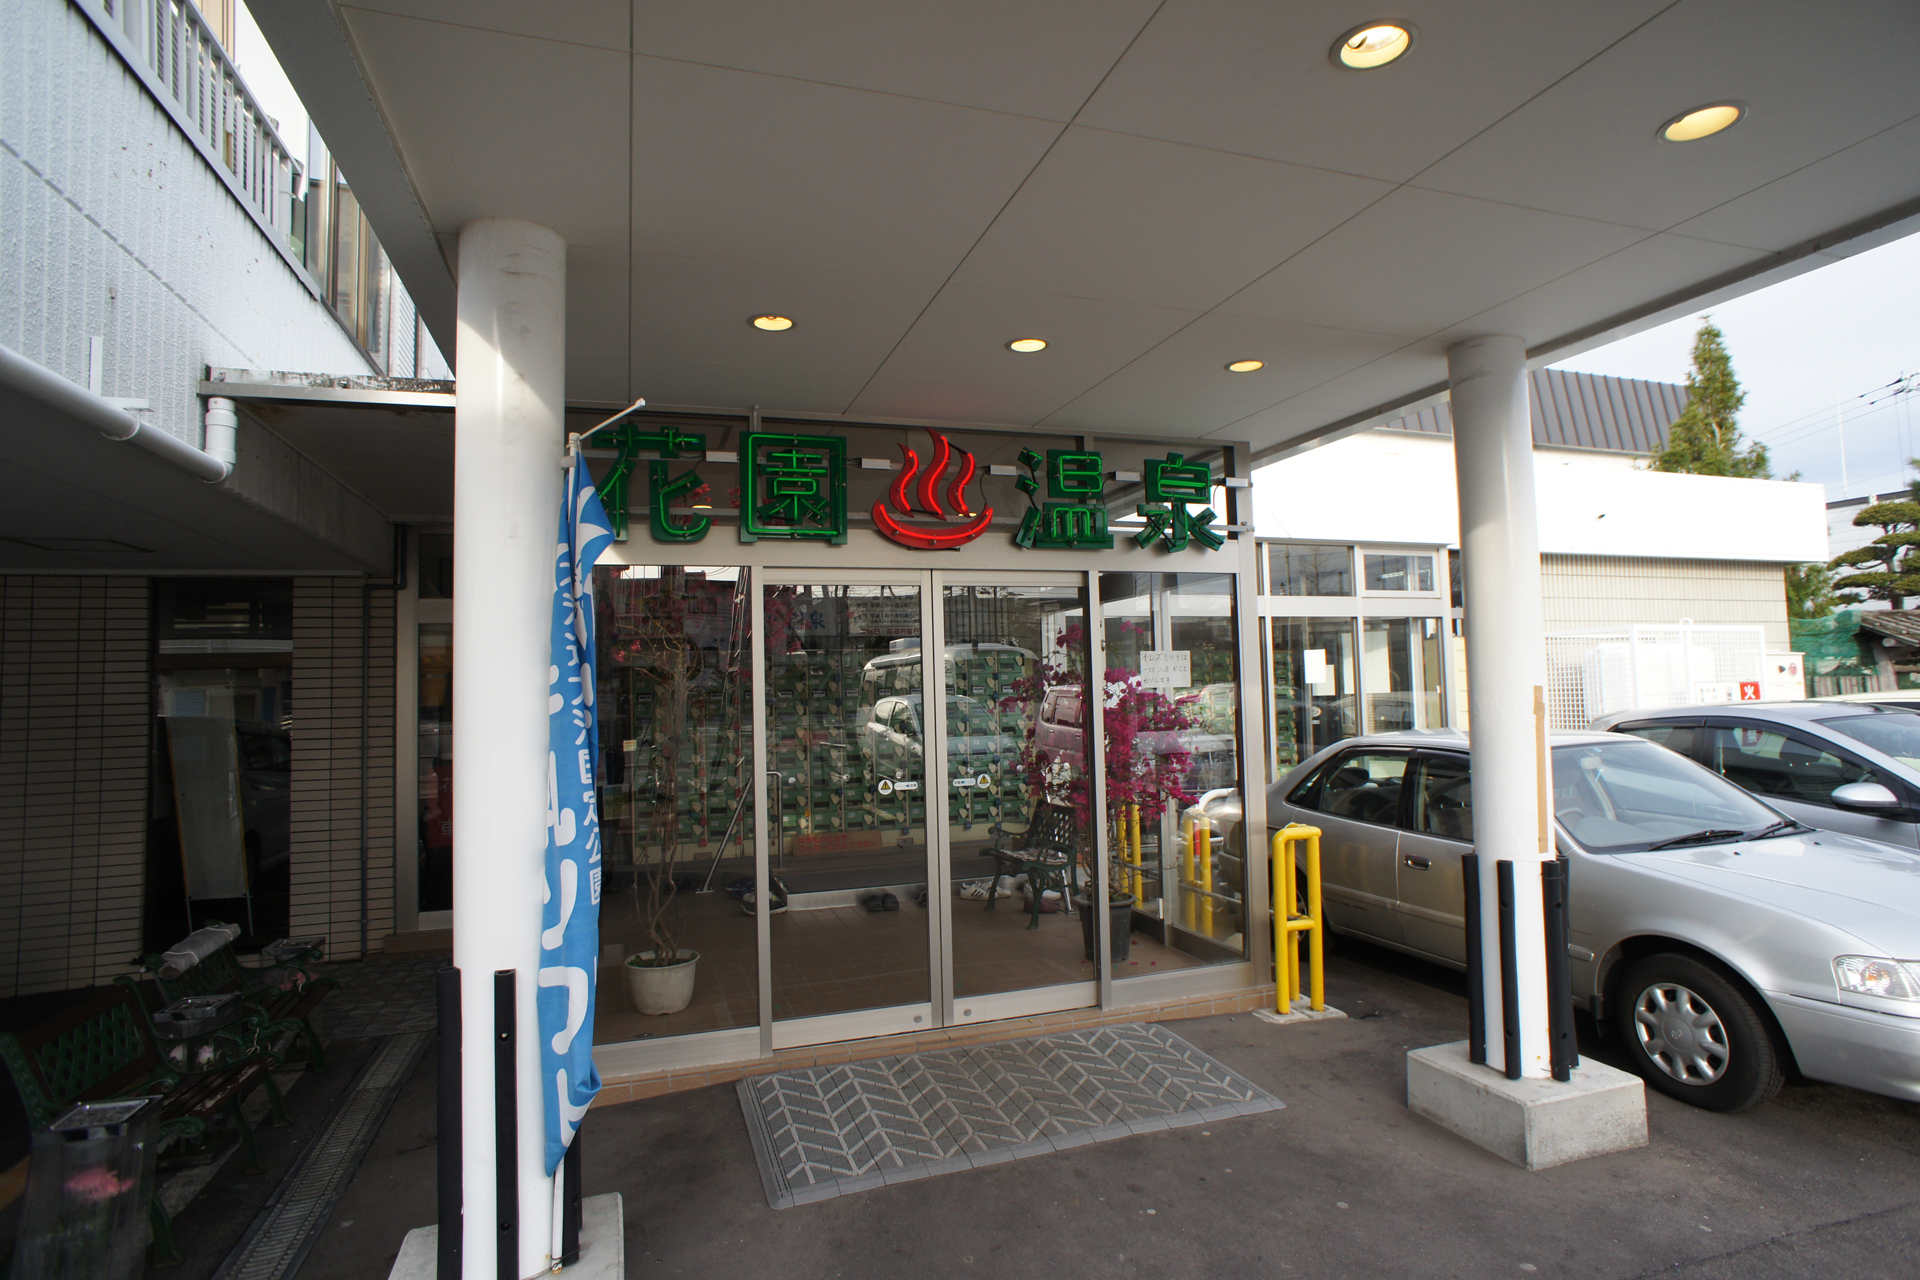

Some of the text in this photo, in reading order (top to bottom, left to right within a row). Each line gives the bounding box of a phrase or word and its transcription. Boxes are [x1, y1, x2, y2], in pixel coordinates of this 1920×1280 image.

[592, 423, 1226, 554] 花園 温泉
[1744, 684, 1756, 700] 火
[798, 840, 877, 852] ロッカーに入れて下さい
